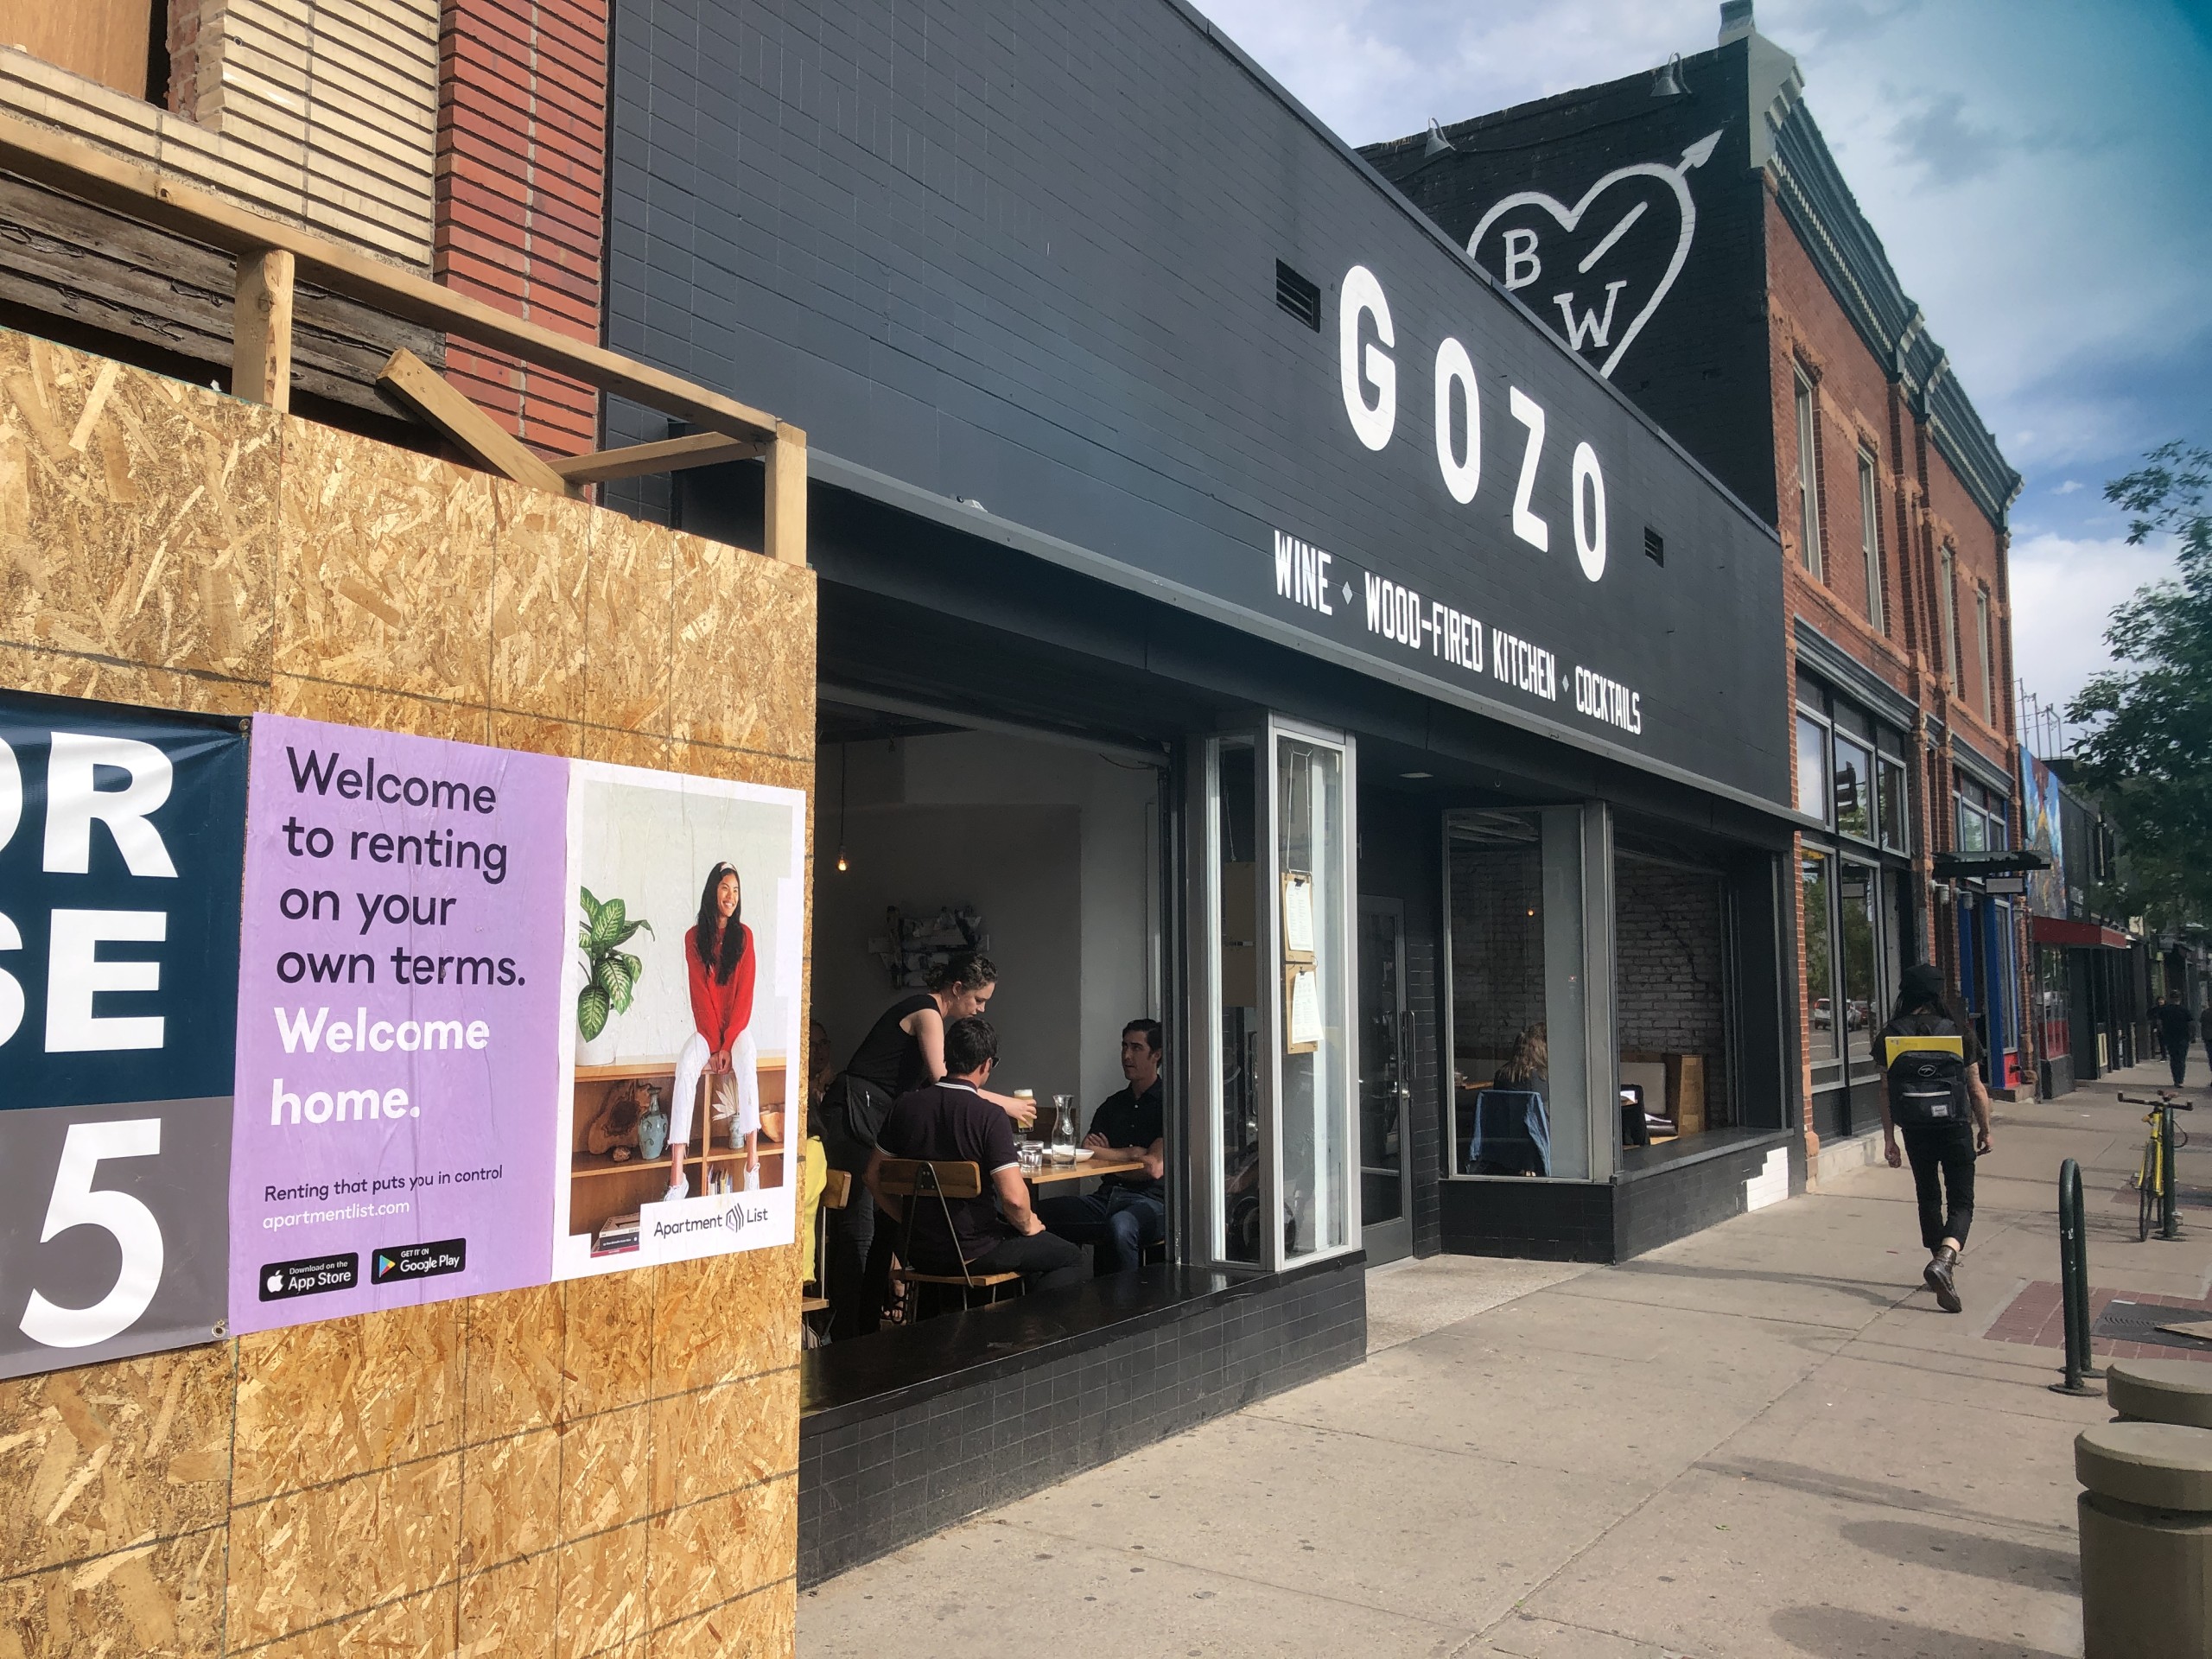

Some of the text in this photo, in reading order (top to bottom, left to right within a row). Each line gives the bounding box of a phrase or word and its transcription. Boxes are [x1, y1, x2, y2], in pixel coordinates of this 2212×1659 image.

[1340, 264, 1607, 582] GOZO
[1274, 529, 1642, 736] WINE WOOD-FIRED KITCHEN COCKTAILS
[286, 746, 497, 815] Welcome
[0, 731, 179, 878] R
[283, 817, 508, 884] to renting
[279, 885, 456, 935] on your
[0, 907, 168, 1054] E
[276, 945, 526, 987] own terms.
[274, 1007, 490, 1053] Welcome
[270, 1077, 421, 1126] home.
[264, 1164, 503, 1202] Renting that puts you in control
[18, 1118, 165, 1349] 5
[262, 1201, 410, 1232] apartmentlist.com
[653, 1207, 768, 1239] Apartment List
[289, 1263, 324, 1274] Download
[336, 1260, 348, 1268] the
[400, 1249, 414, 1258] GET
[400, 1255, 460, 1273] Google Play
[288, 1271, 351, 1291] App Store
